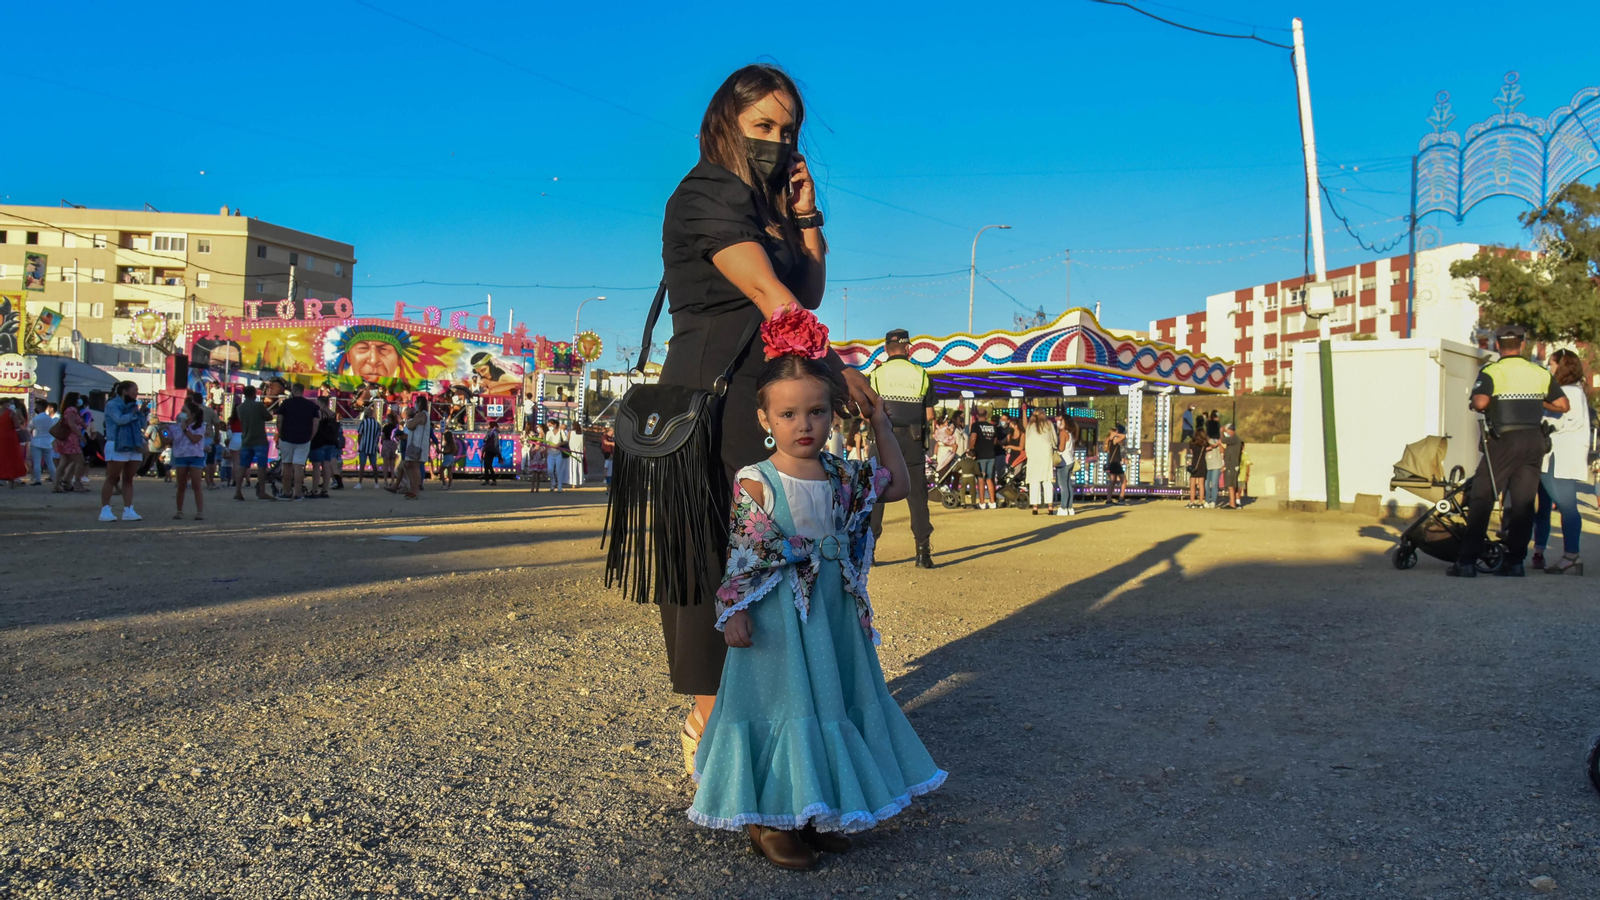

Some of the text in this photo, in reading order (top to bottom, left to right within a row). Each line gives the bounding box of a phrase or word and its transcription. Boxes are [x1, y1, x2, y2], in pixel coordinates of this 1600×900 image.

[244, 298, 496, 335] TORO LOCO
[0, 370, 30, 381] ruja
[889, 381, 917, 390] LOCAL
